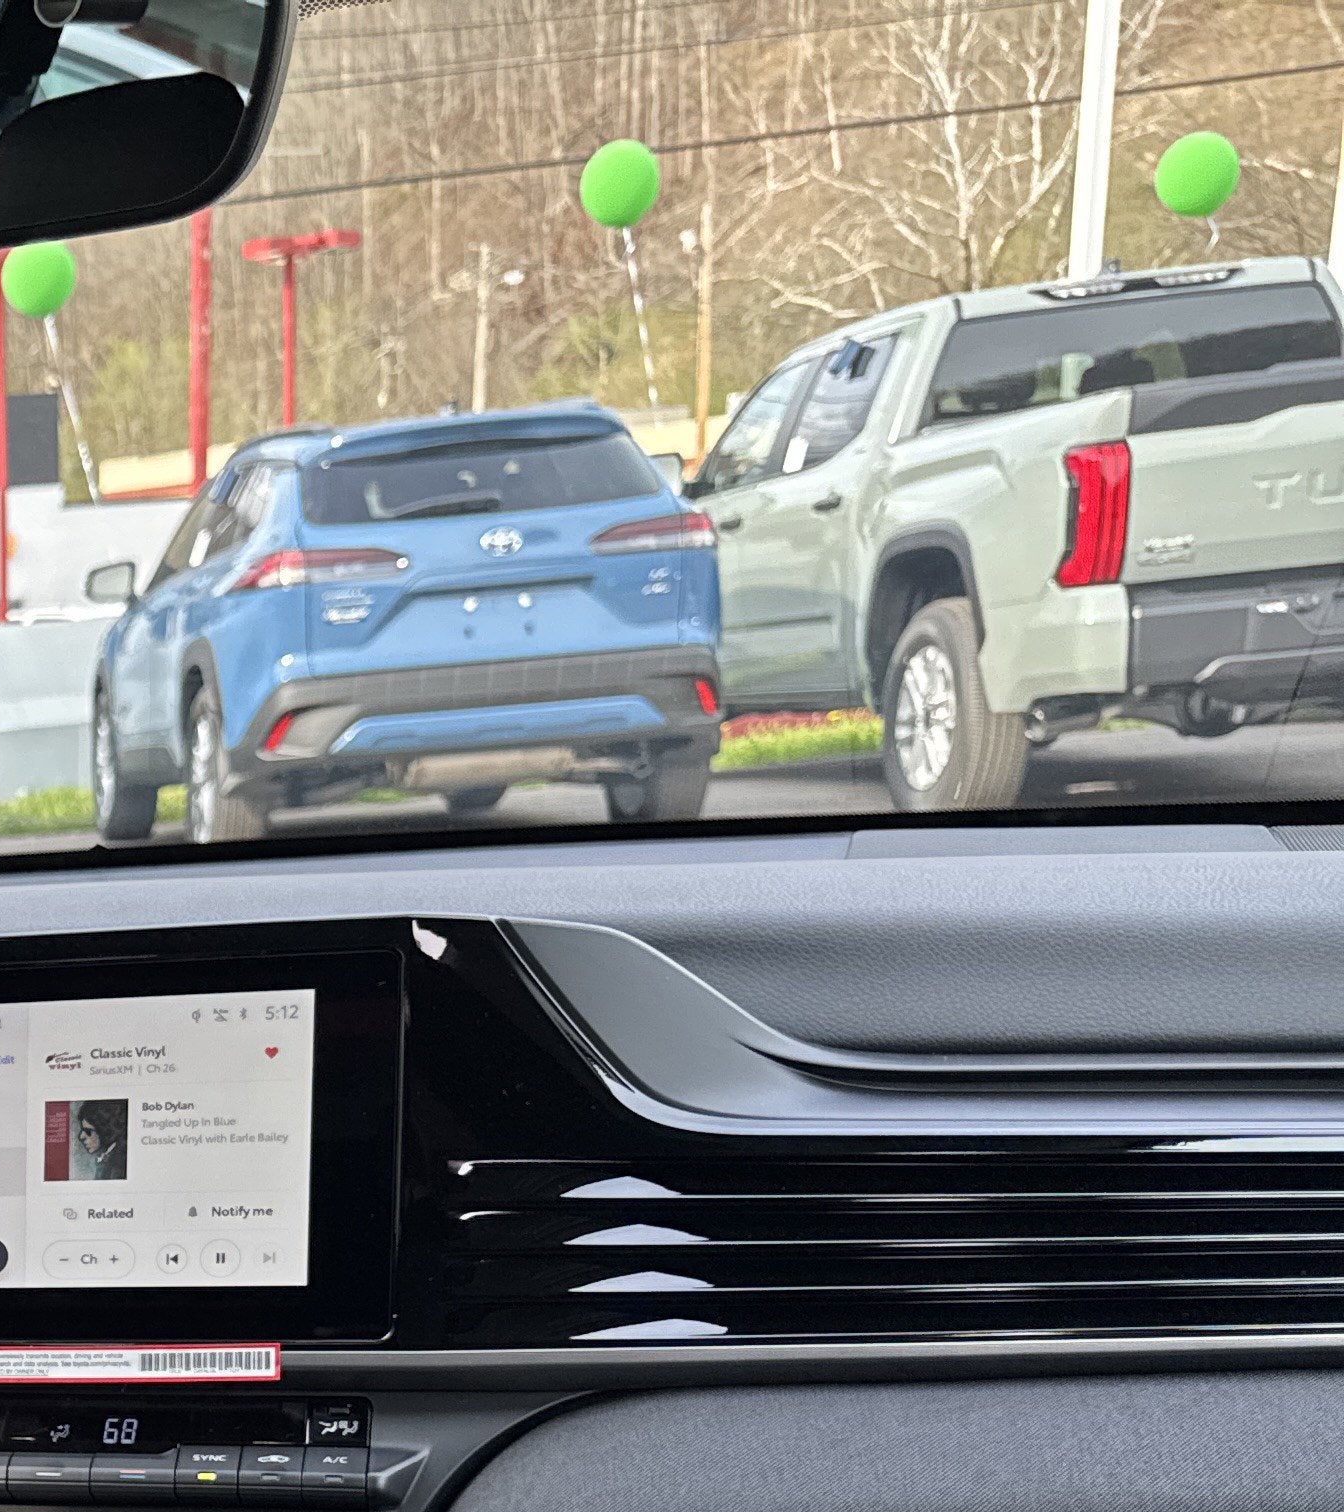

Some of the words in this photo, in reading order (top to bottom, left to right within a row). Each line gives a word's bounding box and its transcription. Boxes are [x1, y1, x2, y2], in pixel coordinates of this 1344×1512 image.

[264, 1004, 300, 1021] 5:12
[90, 1048, 132, 1060] Classic
[134, 1045, 167, 1060] Vinyl
[141, 1101, 163, 1112] Bob
[164, 1100, 195, 1113] Dylan
[141, 1117, 182, 1130] Tangled
[141, 1134, 176, 1146] Classic
[178, 1133, 204, 1146] Vinyl
[88, 1207, 135, 1220] Related
[211, 1205, 250, 1220] Notify
[252, 1207, 274, 1217] me
[80, 1253, 98, 1265] Ch
[102, 1417, 139, 1445] 68
[192, 1453, 228, 1463] SYNC
[322, 1455, 348, 1465] A/C
